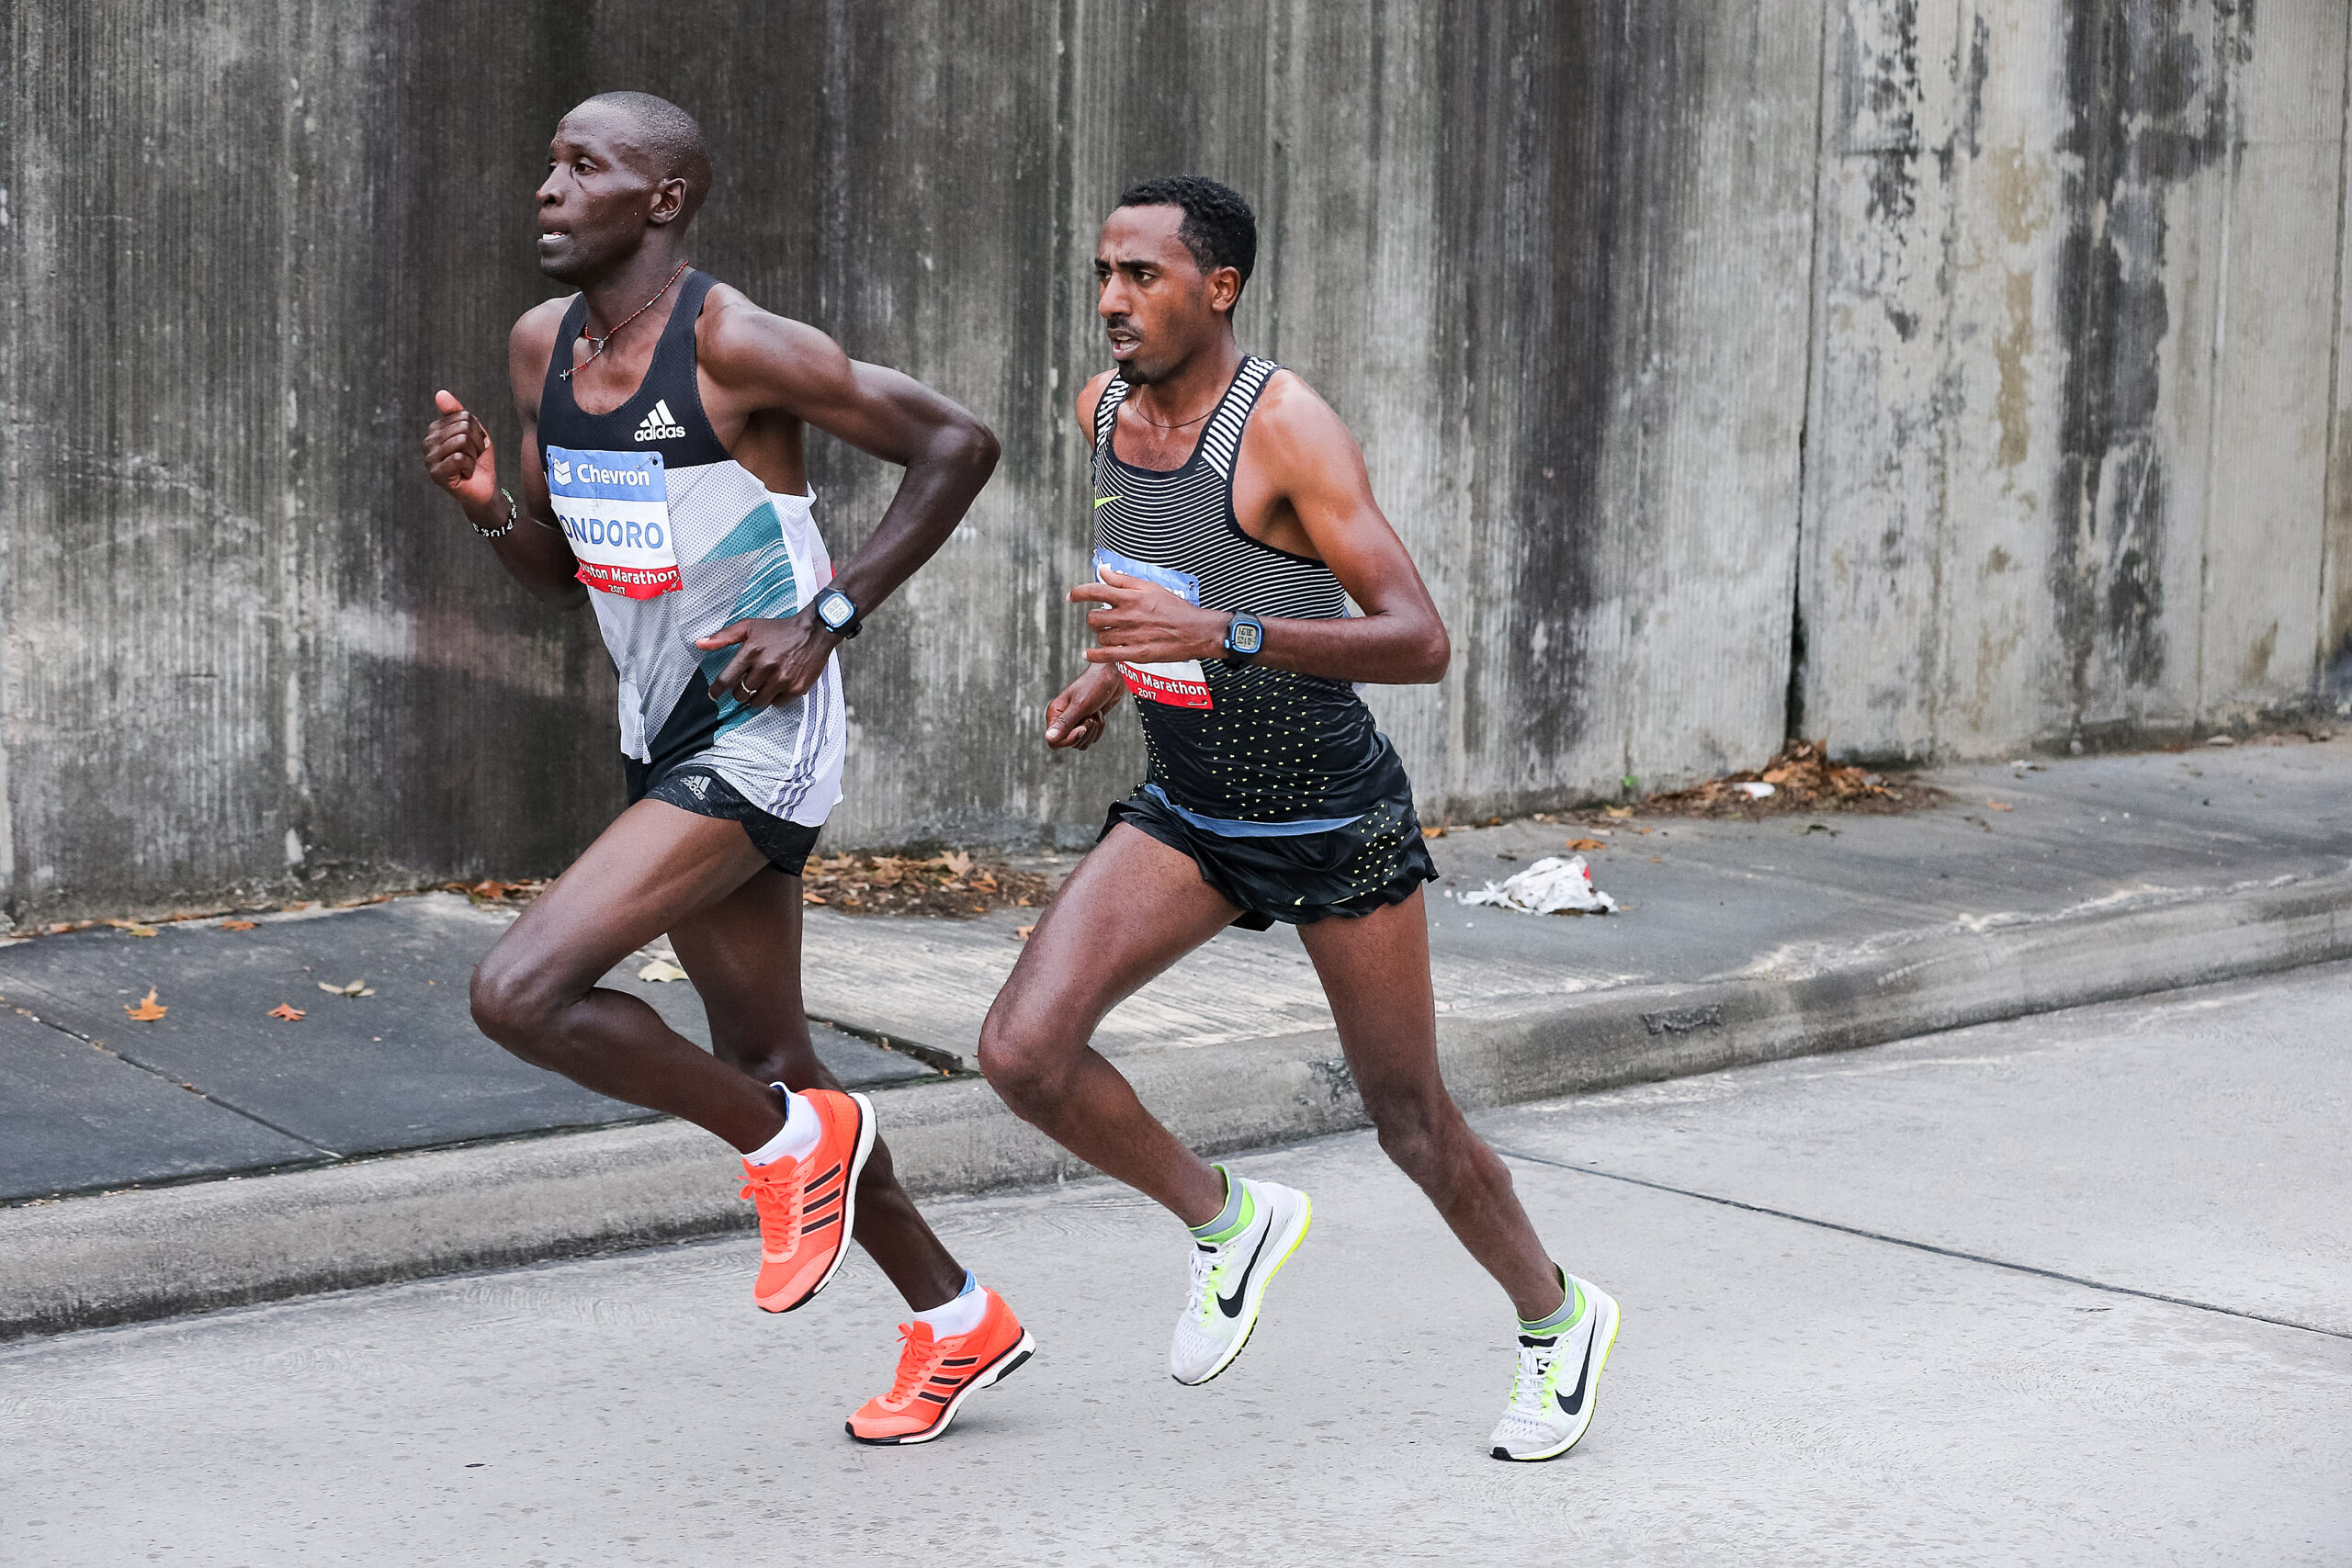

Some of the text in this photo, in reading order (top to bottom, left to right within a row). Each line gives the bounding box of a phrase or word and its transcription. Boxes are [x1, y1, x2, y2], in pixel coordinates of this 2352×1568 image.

[634, 425, 686, 442] adidas
[576, 463, 650, 486] Chevron
[559, 513, 664, 549] ONDORO
[611, 568, 678, 585] Marathon
[608, 584, 626, 595] 2017
[1137, 687, 1157, 700] 2017
[1141, 672, 1207, 696] Marathon
[680, 777, 706, 800] adidas
